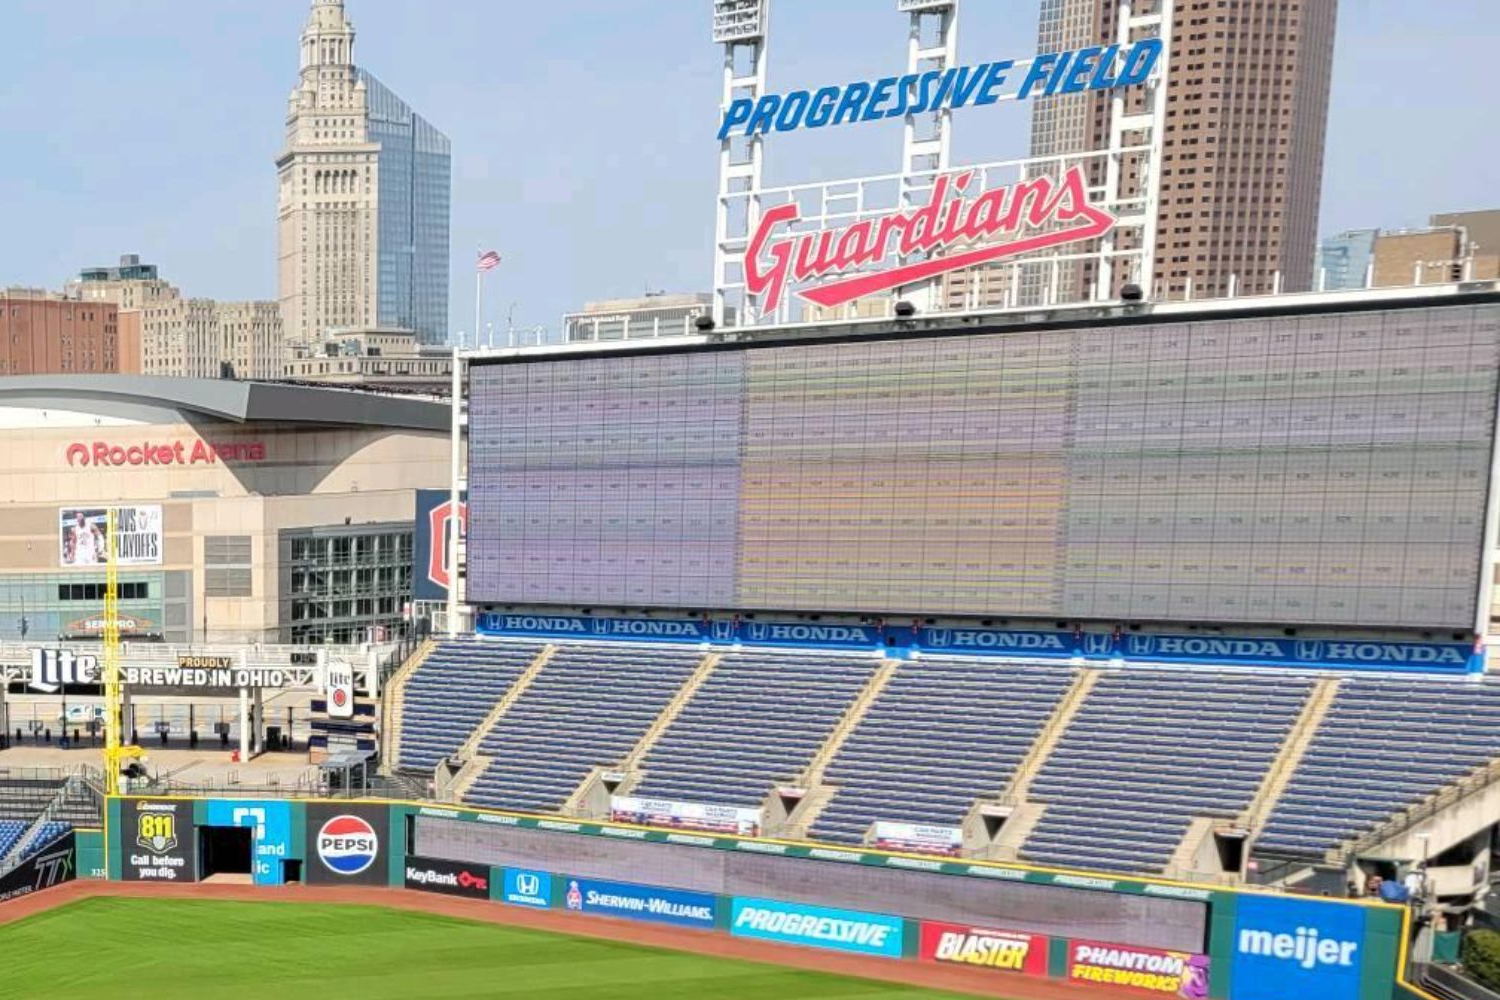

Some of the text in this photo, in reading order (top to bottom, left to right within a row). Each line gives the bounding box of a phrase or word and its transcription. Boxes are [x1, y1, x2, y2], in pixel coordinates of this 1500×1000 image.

[717, 38, 1163, 140] PROGRESSIVE FIELD
[743, 165, 1118, 317] Guardians
[93, 439, 267, 466] Rocket Arena
[505, 616, 585, 632] HONDA
[613, 619, 698, 635] HONDA
[771, 625, 870, 642] HONDA
[953, 631, 1066, 649] HONDA
[1159, 637, 1285, 657] HONDA
[178, 656, 231, 668] PROUDLY
[1326, 642, 1466, 663] HONDA
[31, 649, 99, 693] Lite
[128, 668, 283, 687] BREWED IN OHIO
[141, 815, 172, 838] 811
[321, 838, 374, 850] PEPSI
[131, 854, 185, 866] Call before
[139, 867, 157, 879] you
[406, 867, 458, 886] KeyBank
[735, 907, 892, 947] PROGRESSIVE
[936, 931, 1029, 970] BLASTER
[1238, 926, 1358, 969] meijer
[1074, 945, 1184, 974] PHANTOM
[1071, 963, 1181, 991] FIREWORKS
